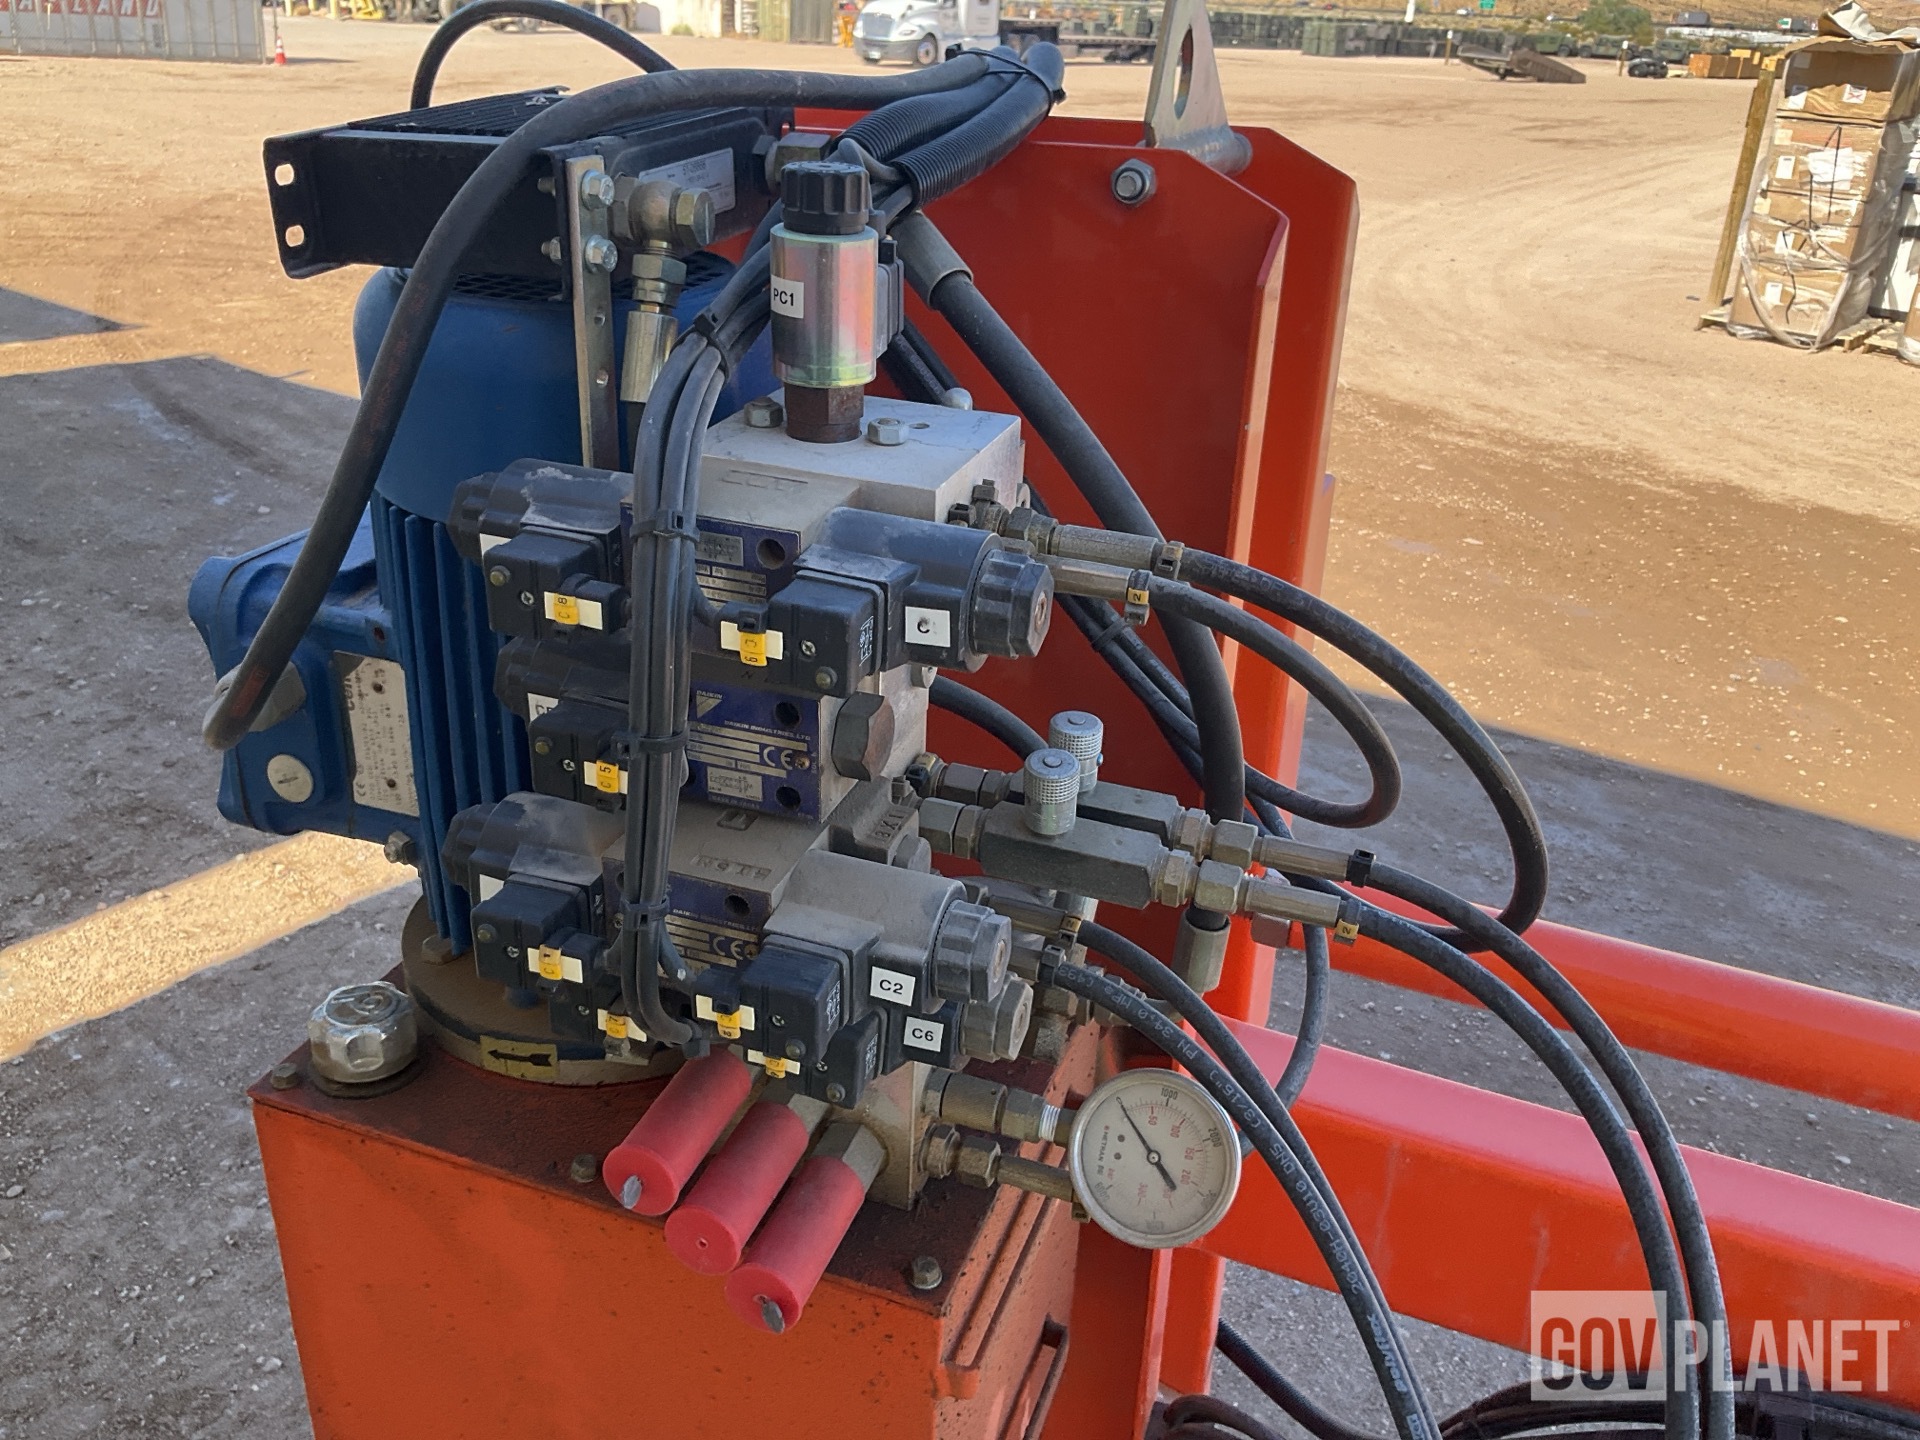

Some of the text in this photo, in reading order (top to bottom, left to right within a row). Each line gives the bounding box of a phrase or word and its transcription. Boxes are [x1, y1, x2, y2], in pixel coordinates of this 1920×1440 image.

[773, 287, 794, 307] PC1
[696, 690, 723, 699] DAIKIN
[724, 720, 749, 730] DAIKIN
[879, 979, 904, 995] C2
[1104, 985, 1131, 1009] MPa
[911, 1027, 934, 1042] C6
[1177, 1041, 1199, 1060] PN
[1161, 1087, 1178, 1100] 1000
[1148, 1116, 1158, 1126] 50
[1170, 1125, 1180, 1139] 100
[1208, 1127, 1222, 1148] 2000
[1184, 1147, 1195, 1160] 150
[1270, 1143, 1296, 1175] DN5
[1180, 1169, 1191, 1185] 200
